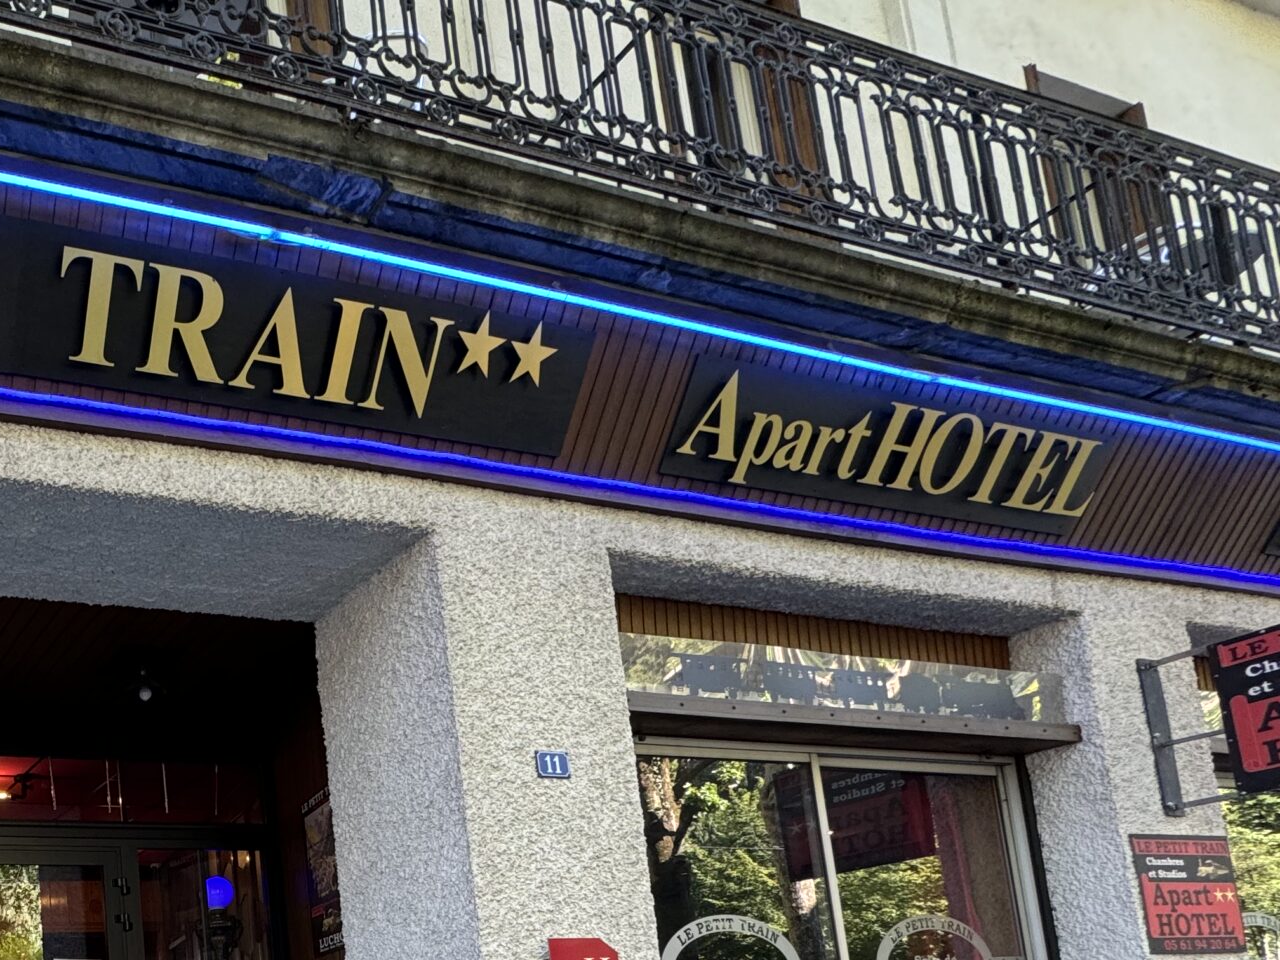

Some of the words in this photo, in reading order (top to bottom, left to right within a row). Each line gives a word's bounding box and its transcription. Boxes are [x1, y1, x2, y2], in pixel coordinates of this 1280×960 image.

[59, 245, 457, 420] TRAIN
[676, 368, 1105, 519] ApartHOTEL
[1228, 639, 1270, 663] LE
[1245, 659, 1280, 678] Ch
[1247, 680, 1274, 697] et
[544, 755, 563, 774] 11
[1135, 841, 1152, 853] LE
[1156, 841, 1189, 853] PETIT
[1192, 842, 1228, 854] TRAIN
[1145, 857, 1185, 866] Chambres
[1148, 870, 1157, 878] et
[1157, 869, 1188, 879] Studios
[1153, 883, 1214, 913] Apart
[676, 927, 695, 946] LE
[695, 918, 735, 935] PETIT
[739, 919, 780, 945] TRAIN
[890, 927, 904, 944] LE
[904, 918, 937, 932] PETIT
[941, 919, 975, 941] TRAIN
[1156, 913, 1236, 937] HOTEL
[1163, 939, 1178, 952] 05
[1180, 939, 1193, 951] 61
